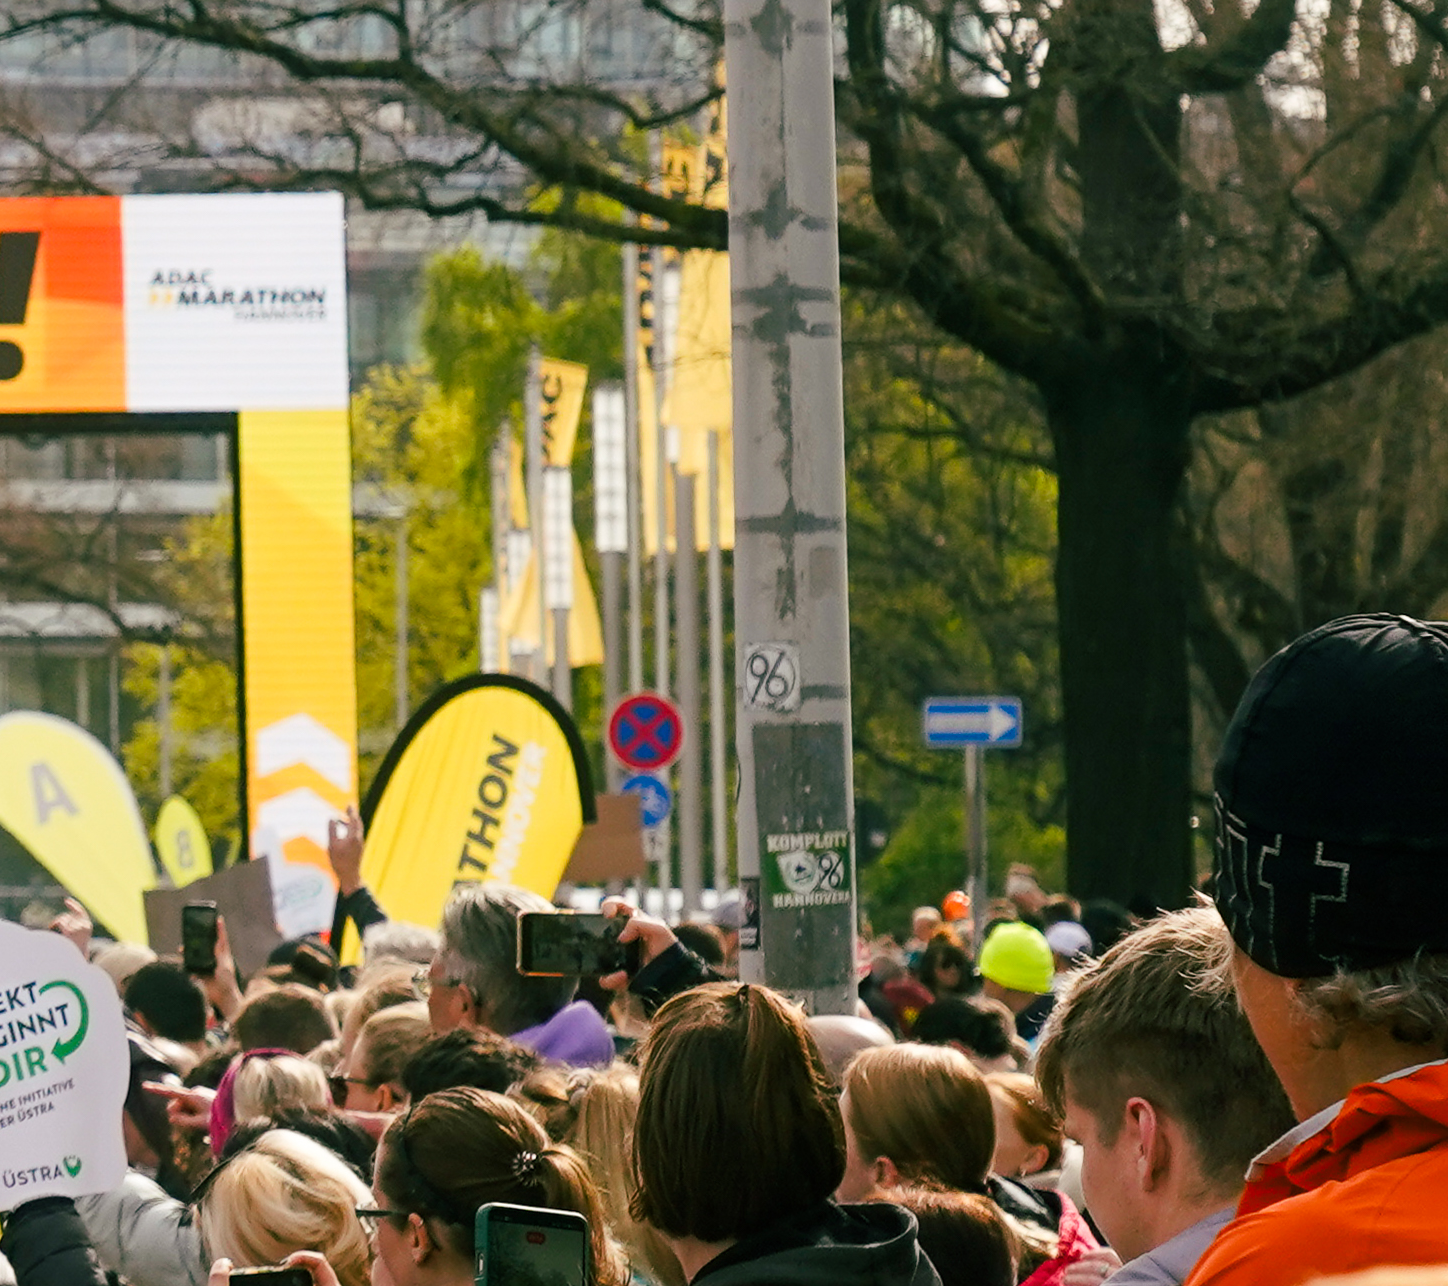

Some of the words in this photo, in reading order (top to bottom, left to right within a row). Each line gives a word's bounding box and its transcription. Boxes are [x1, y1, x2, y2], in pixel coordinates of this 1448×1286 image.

[152, 270, 212, 284] ADAC
[178, 288, 325, 304] MARATHON
[748, 651, 789, 705] 96
[31, 762, 79, 825] A
[453, 733, 520, 890] THON
[766, 832, 848, 853] KOMPLOTT
[18, 1078, 76, 1107] INITIATIVE
[17, 1102, 54, 1122] ÜSTRA
[2, 1164, 64, 1188] ÜSTRA
